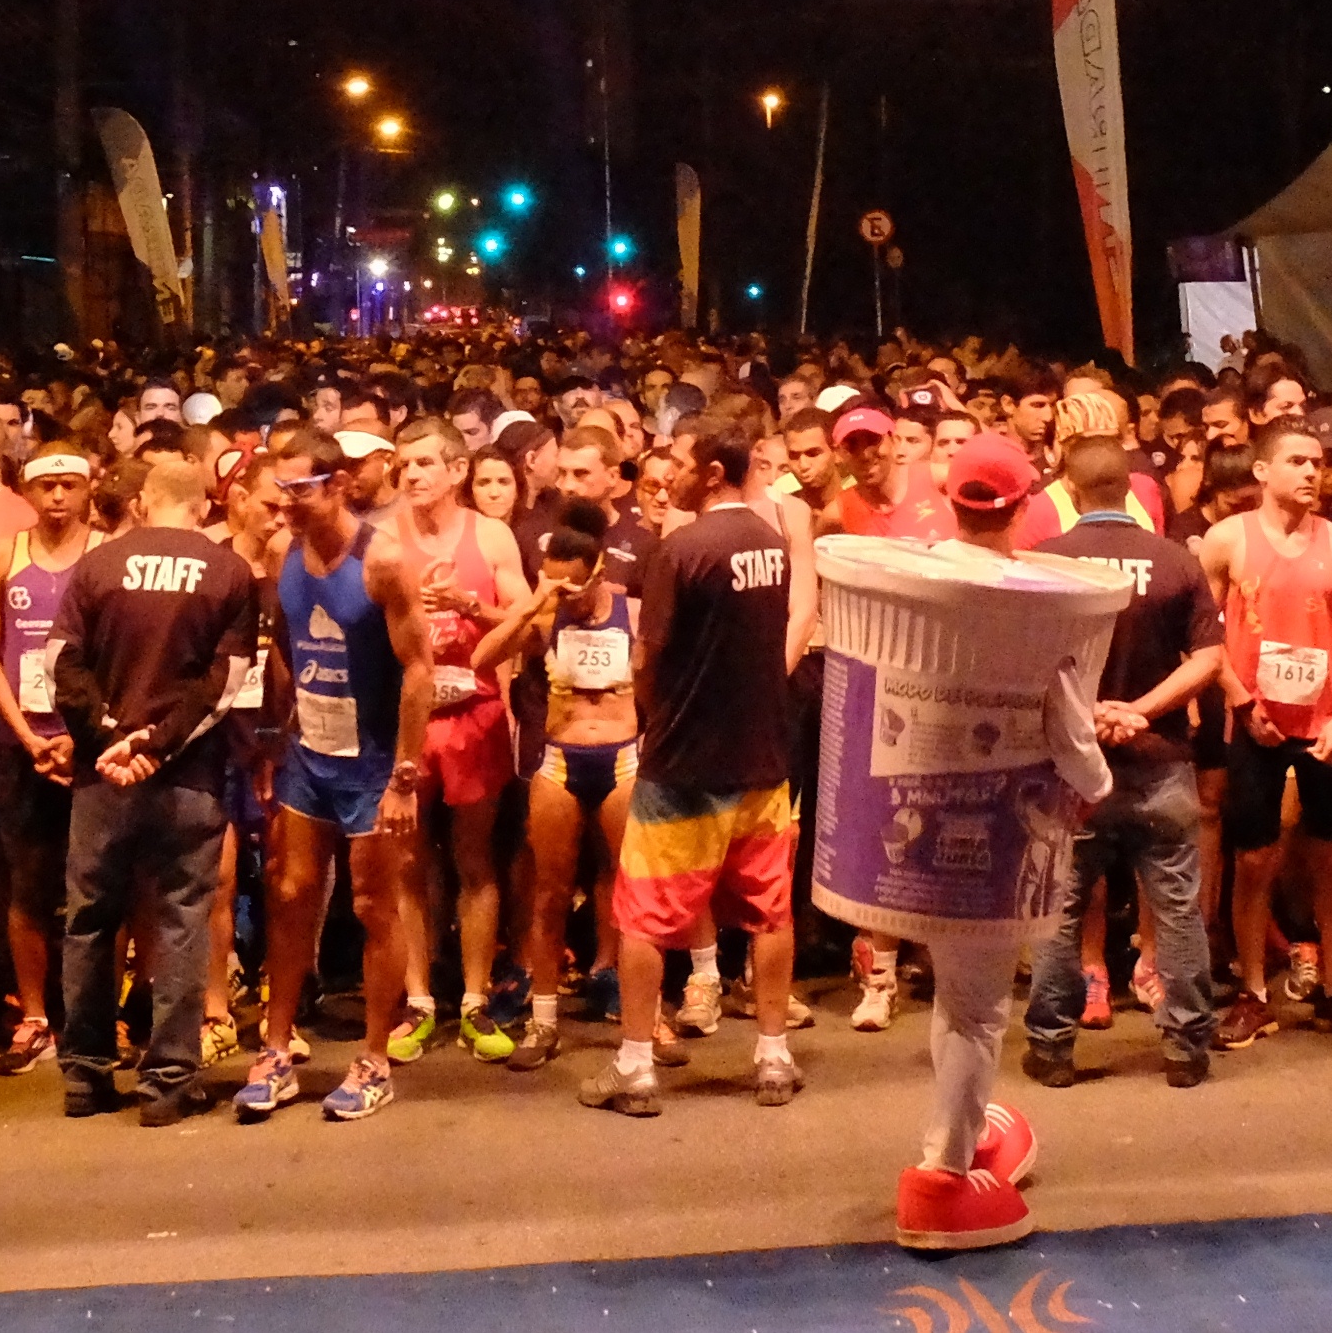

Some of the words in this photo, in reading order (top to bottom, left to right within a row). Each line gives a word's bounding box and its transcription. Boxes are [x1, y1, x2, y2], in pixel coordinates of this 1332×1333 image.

[122, 553, 207, 593] STAFF
[730, 548, 785, 592] STAFF
[578, 649, 611, 667] 253
[1276, 663, 1316, 682] 1614
